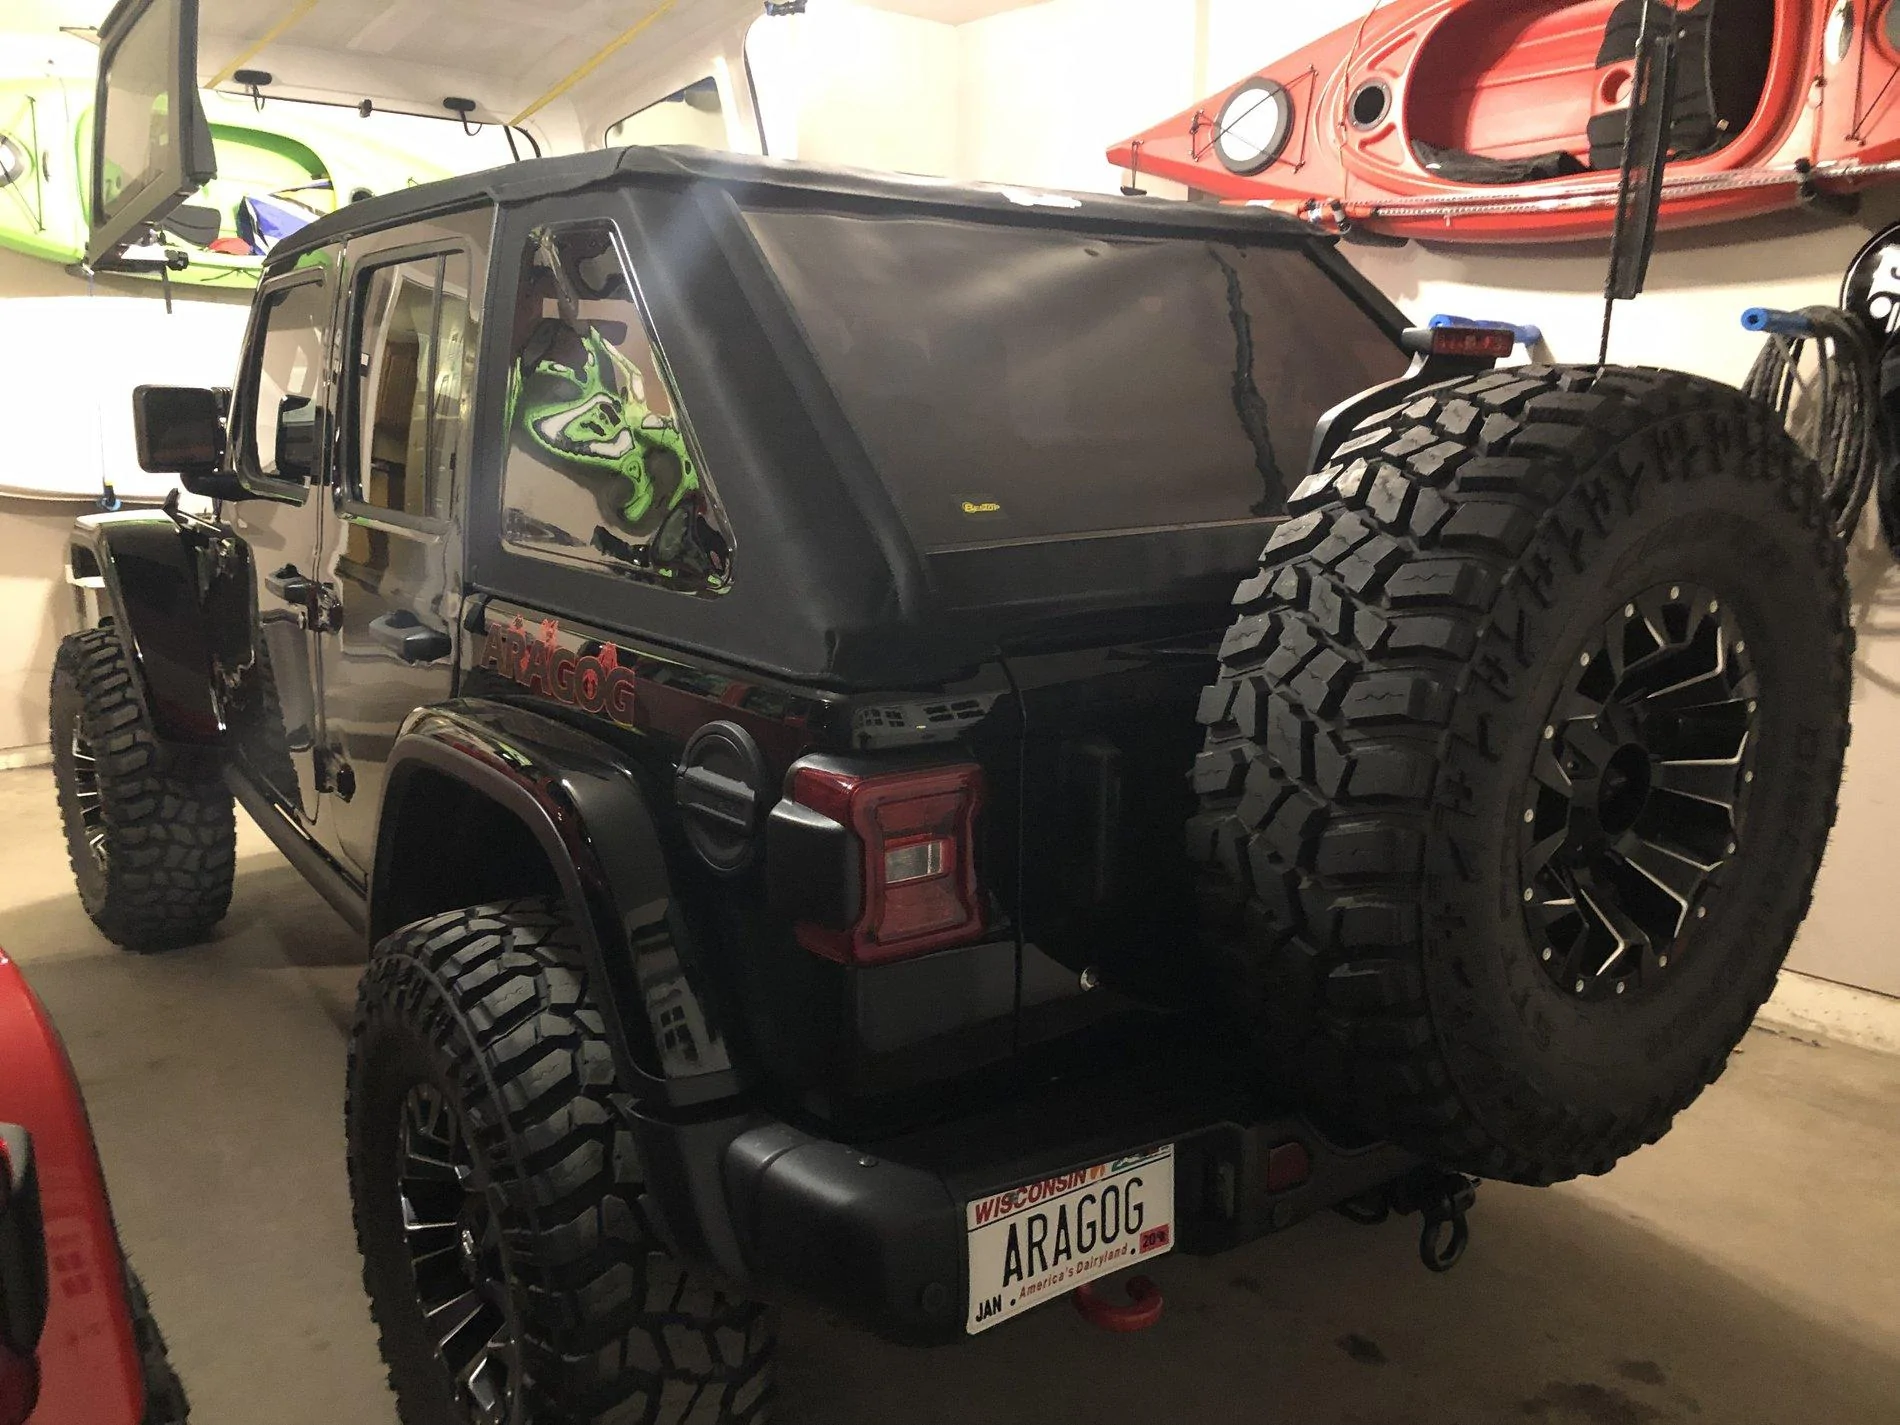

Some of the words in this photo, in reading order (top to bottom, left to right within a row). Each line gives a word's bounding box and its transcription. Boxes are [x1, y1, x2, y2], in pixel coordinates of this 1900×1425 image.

[480, 618, 635, 727] ARAGOG
[976, 1168, 1087, 1225] WISCONSIN
[1002, 1177, 1144, 1288] ARAGOG
[1019, 1265, 1074, 1300] America's
[1076, 1243, 1128, 1274] Dairyland
[975, 1294, 1002, 1322] JAN
